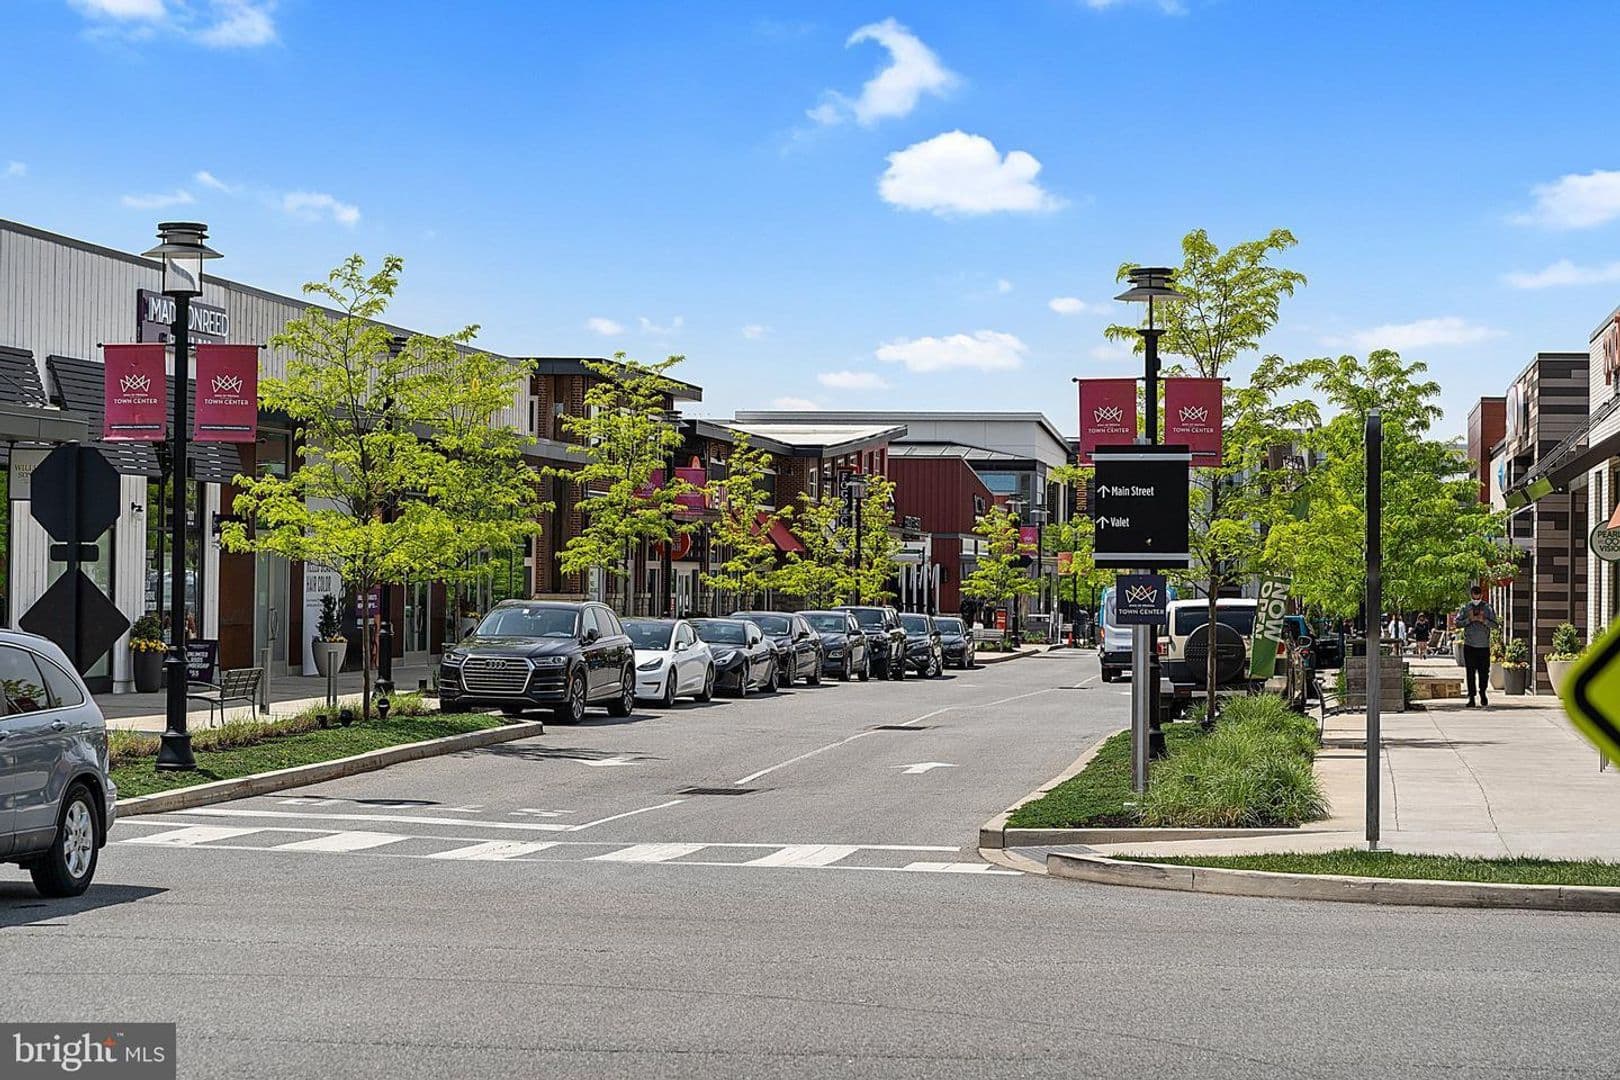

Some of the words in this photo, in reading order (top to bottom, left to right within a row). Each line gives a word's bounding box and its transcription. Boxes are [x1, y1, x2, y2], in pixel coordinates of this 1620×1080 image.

[148, 296, 230, 338] MADONREED
[1111, 486, 1130, 497] Main
[1130, 486, 1154, 497] Street
[1110, 516, 1129, 527] Valet
[1255, 580, 1274, 640] OPEN
[1264, 581, 1291, 642] NOW
